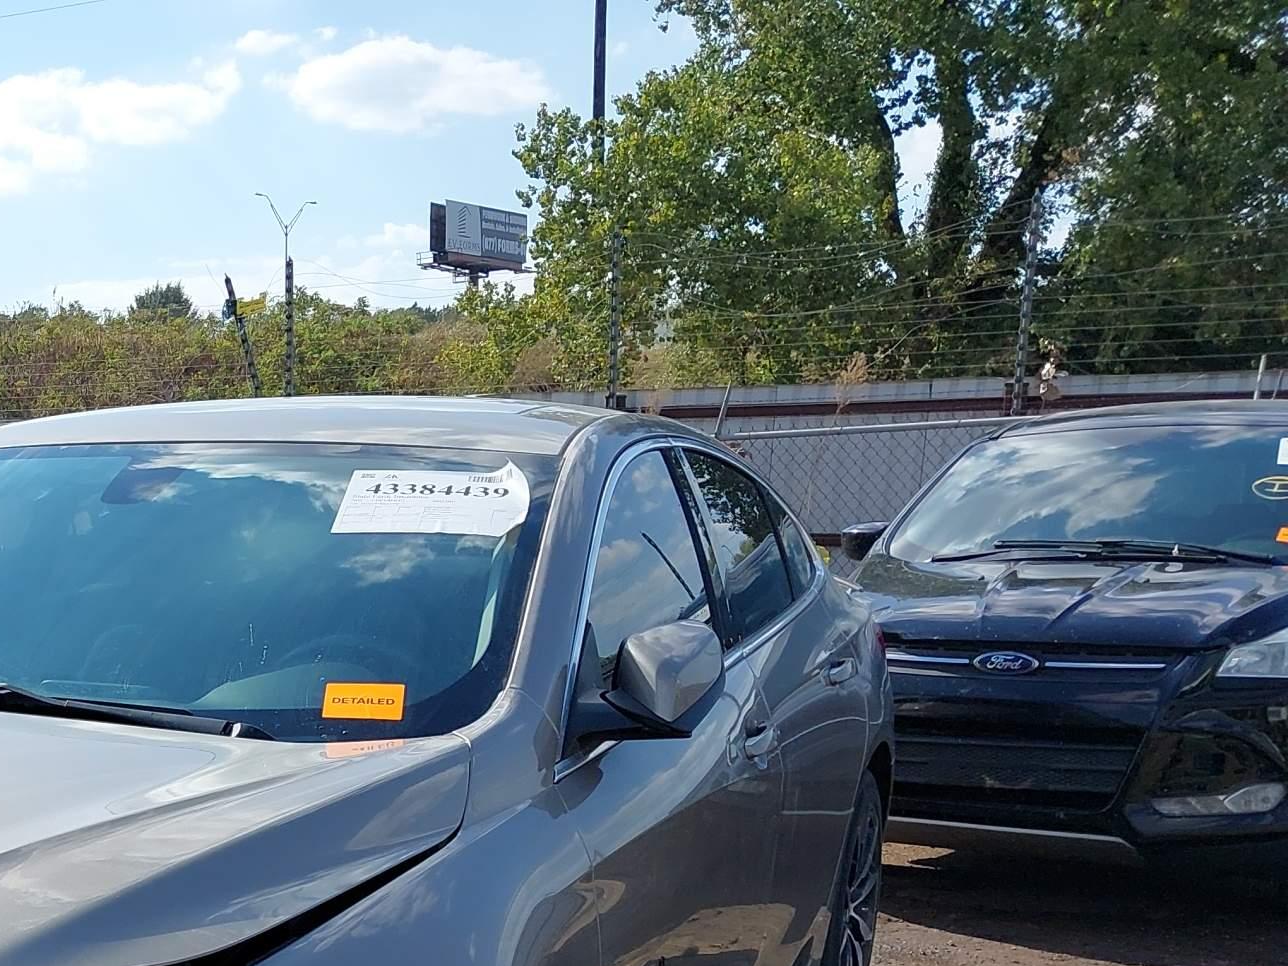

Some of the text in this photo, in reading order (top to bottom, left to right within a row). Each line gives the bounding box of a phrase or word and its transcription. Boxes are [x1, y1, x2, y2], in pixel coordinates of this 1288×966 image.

[365, 483, 510, 498] 43384439
[986, 654, 1024, 670] Ford
[332, 697, 396, 706] DETAILED
